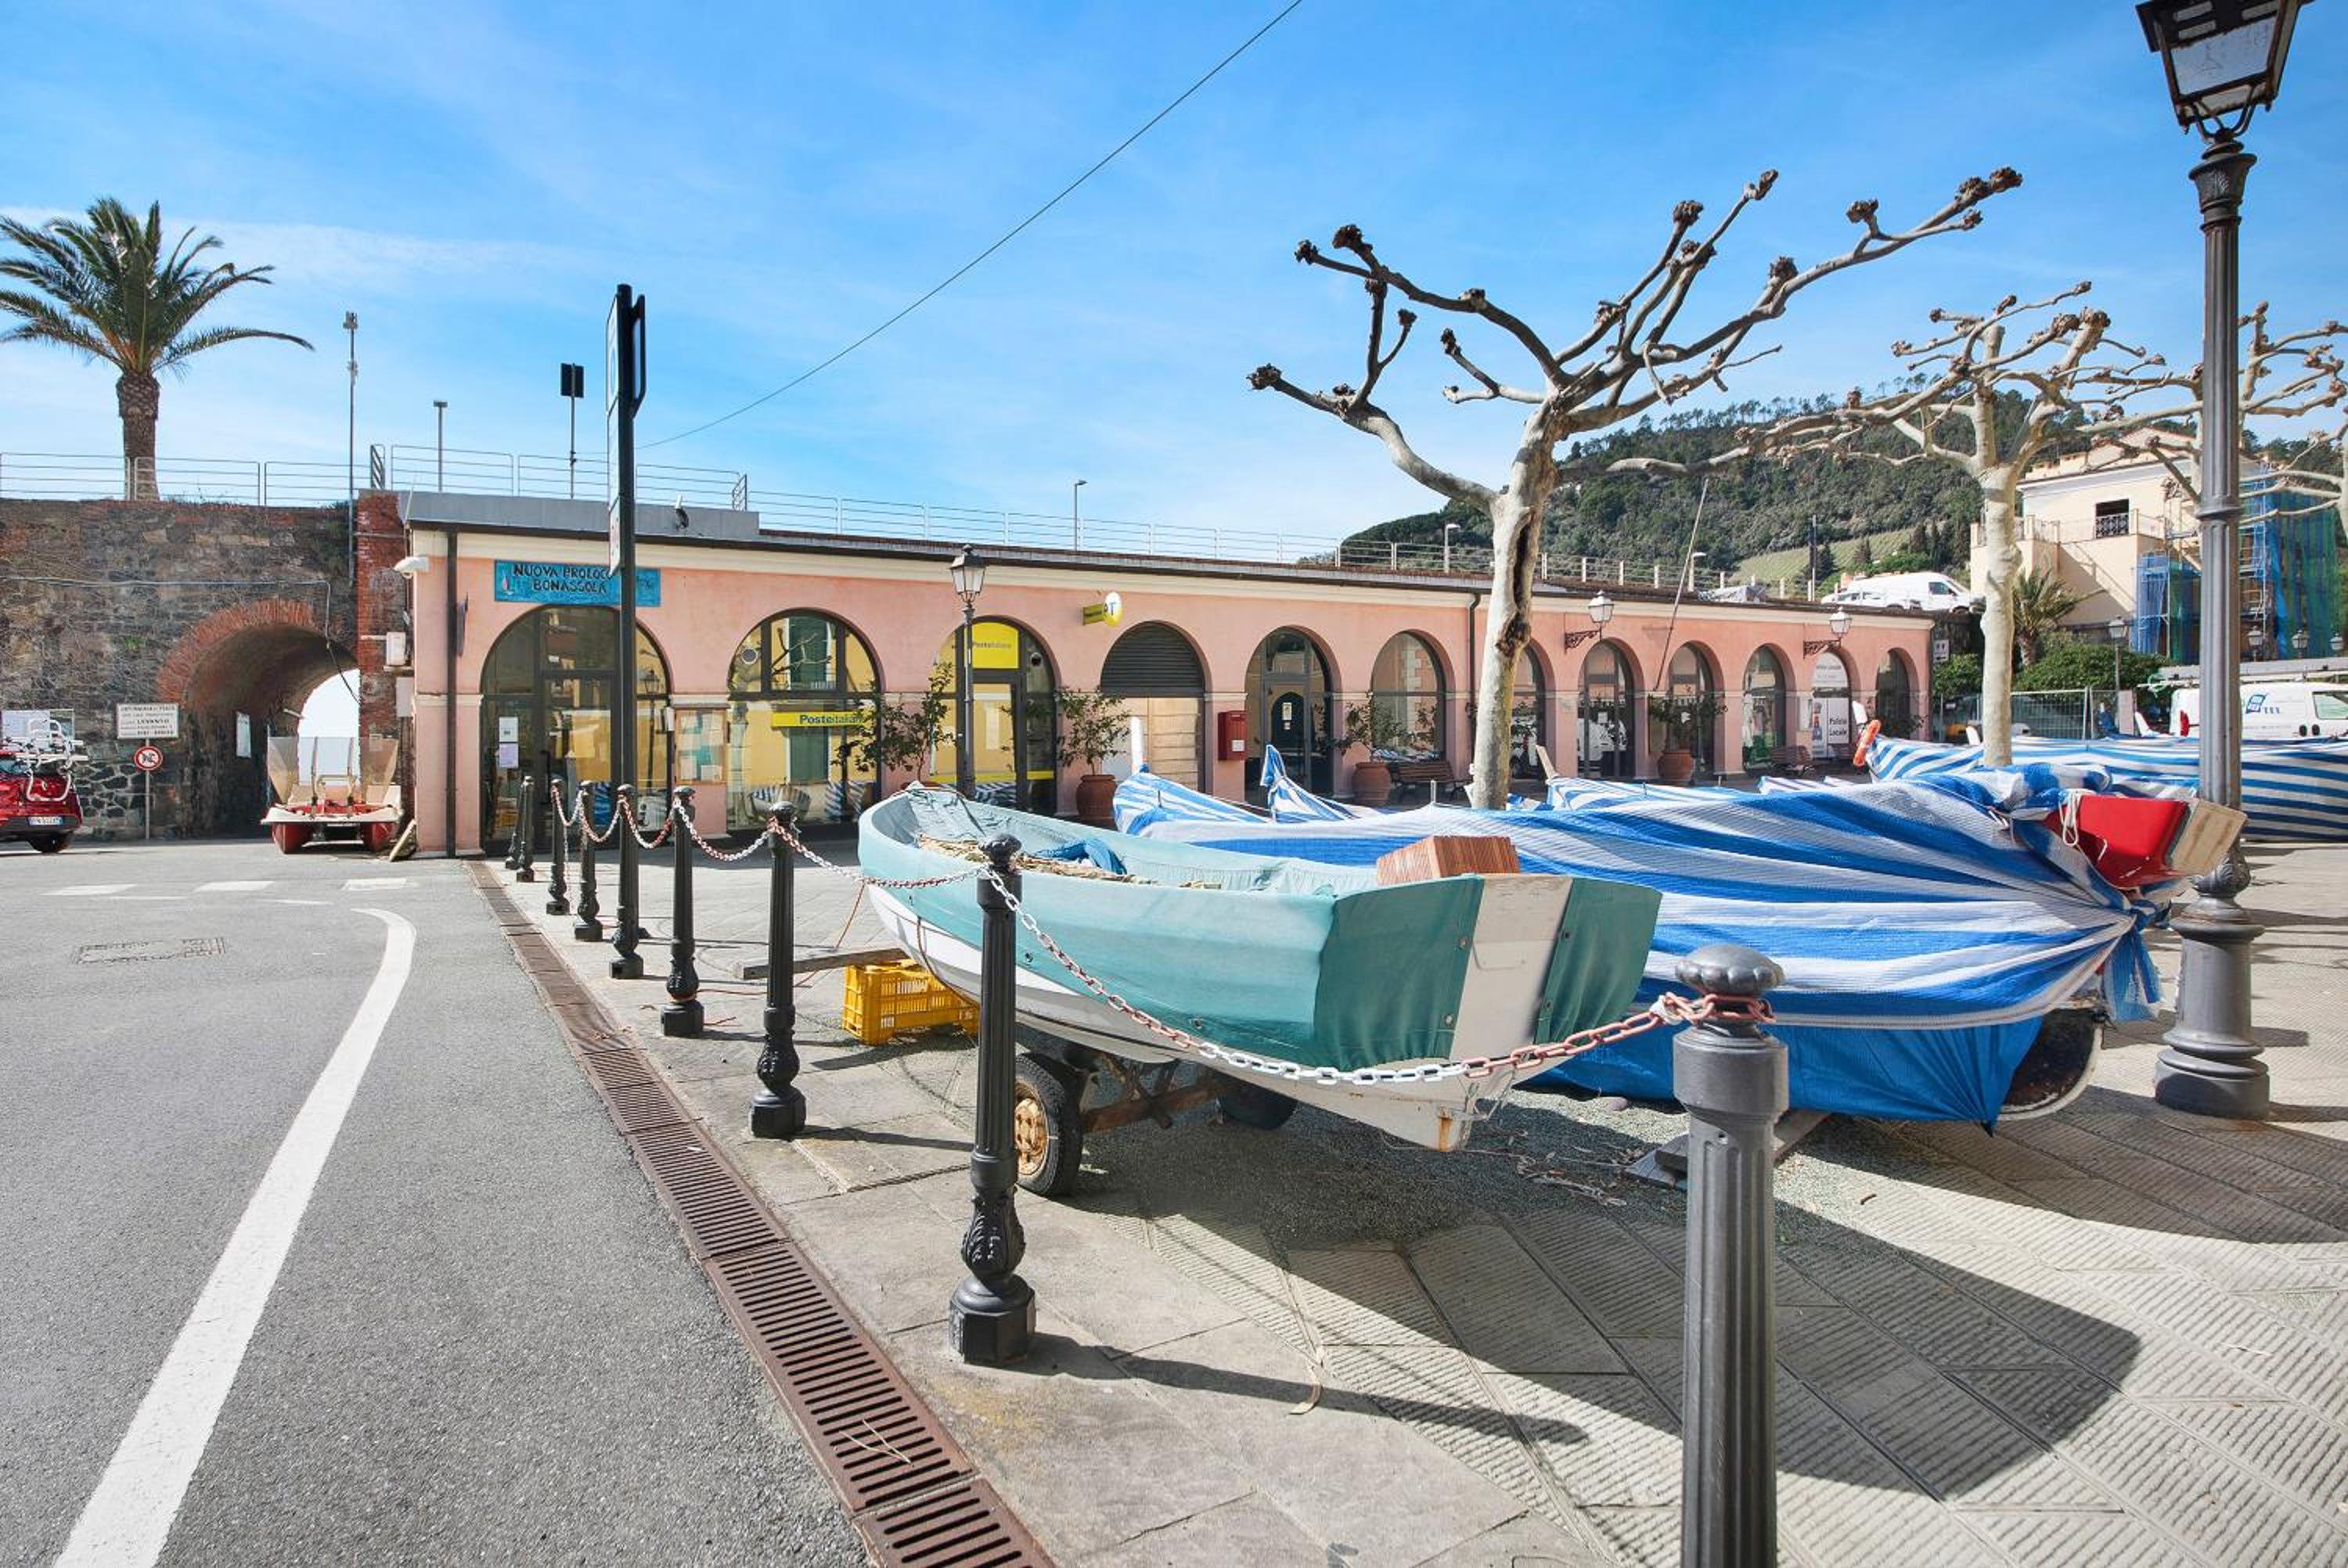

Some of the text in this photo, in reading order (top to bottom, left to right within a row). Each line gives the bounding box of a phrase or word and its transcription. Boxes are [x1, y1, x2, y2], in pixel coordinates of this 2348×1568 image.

[513, 564, 613, 580] NUOVA PROLOCO
[533, 580, 607, 595] BONASSOLA
